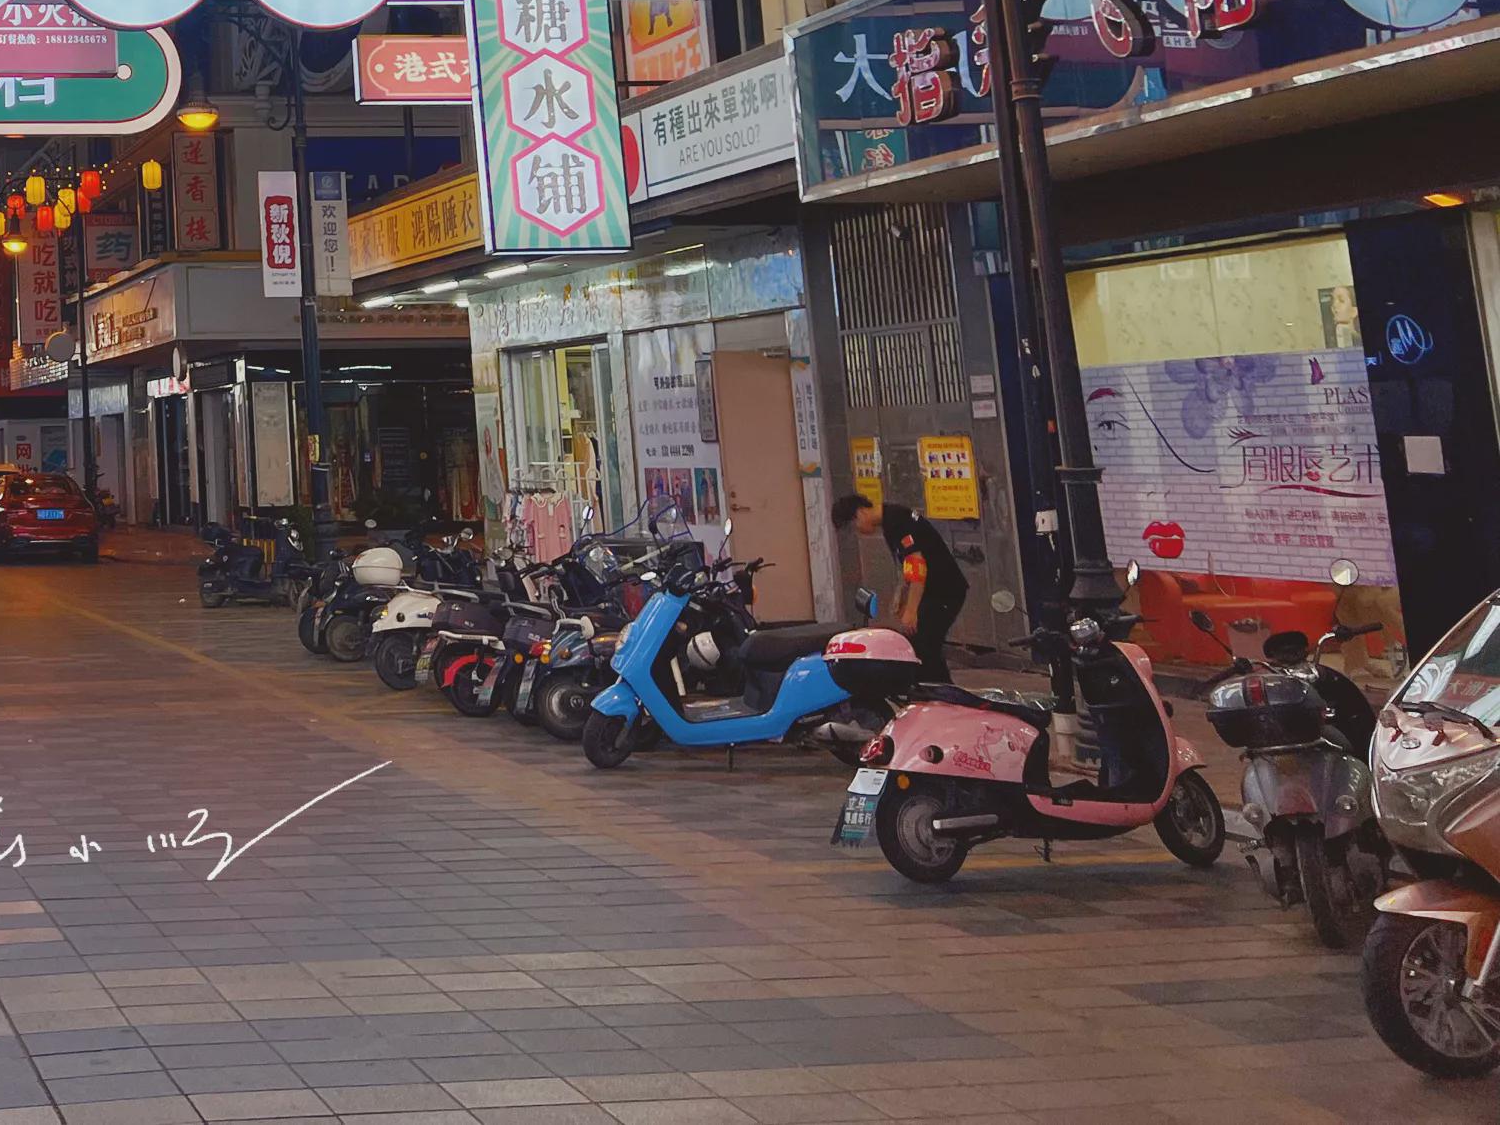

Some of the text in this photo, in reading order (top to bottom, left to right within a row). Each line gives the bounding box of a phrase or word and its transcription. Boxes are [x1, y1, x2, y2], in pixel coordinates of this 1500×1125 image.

[652, 73, 787, 147] 有種出來單挑啊!
[679, 123, 762, 169] ARE YOU SOLO?
